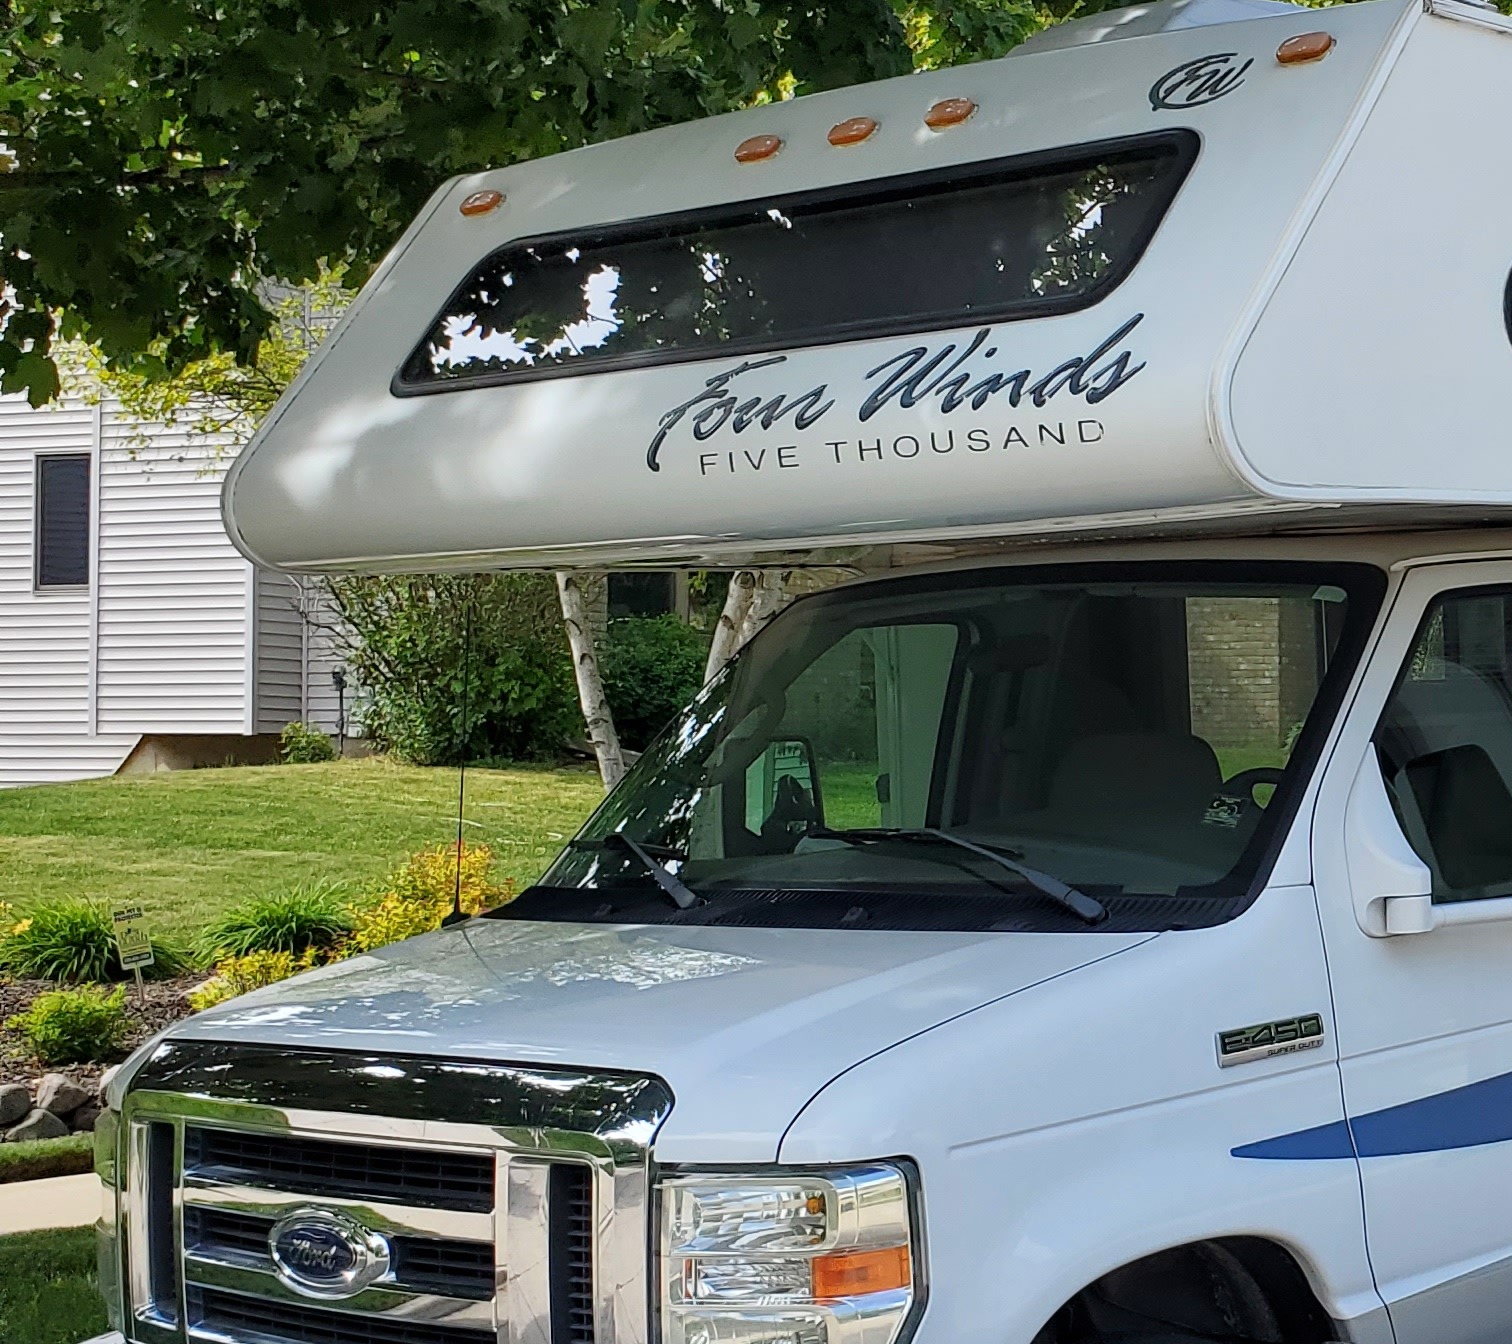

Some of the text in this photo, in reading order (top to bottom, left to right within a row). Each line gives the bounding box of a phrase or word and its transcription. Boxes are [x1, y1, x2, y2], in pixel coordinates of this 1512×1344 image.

[646, 312, 1148, 473] Four Winds
[700, 419, 1105, 476] FIVE THOUSAND
[1267, 1039, 1322, 1056] SUPER DUTY
[288, 1229, 337, 1270] Ford
